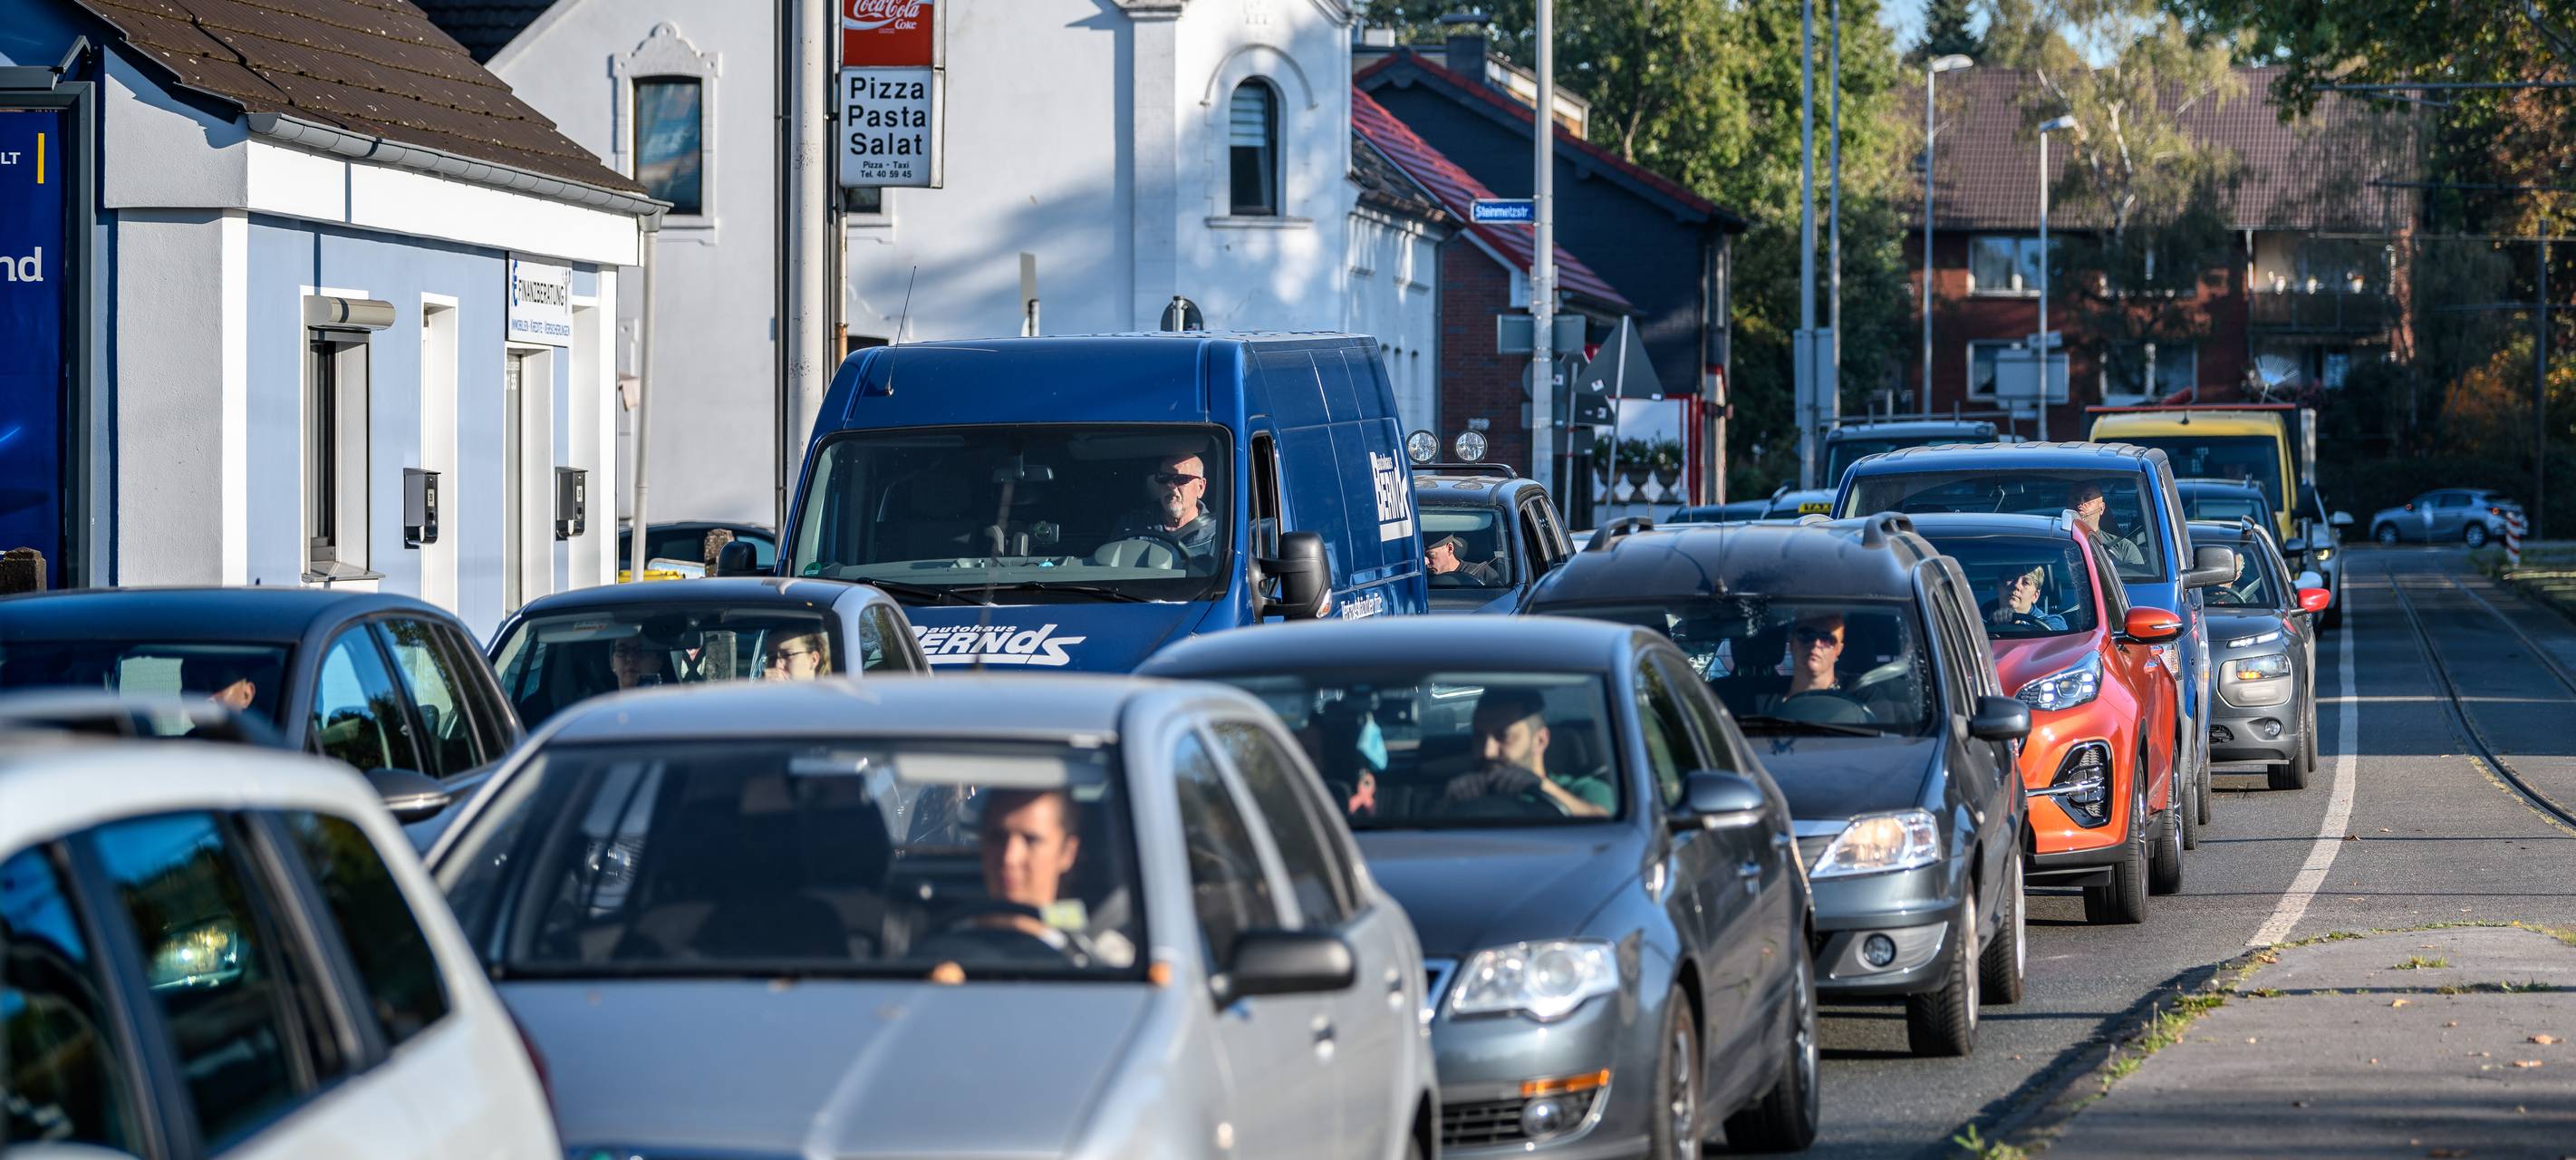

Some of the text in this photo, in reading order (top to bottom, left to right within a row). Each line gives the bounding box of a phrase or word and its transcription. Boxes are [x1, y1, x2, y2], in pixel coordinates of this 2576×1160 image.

[894, 19, 917, 30] Coke
[850, 76, 924, 100] Pizza
[847, 104, 926, 127] Pasta
[850, 132, 922, 155] Salat
[876, 169, 886, 179] 40
[889, 169, 899, 179] 59
[902, 169, 912, 179] 45
[518, 278, 564, 307] FINANZBERATUNG
[926, 624, 1018, 633] autohaus
